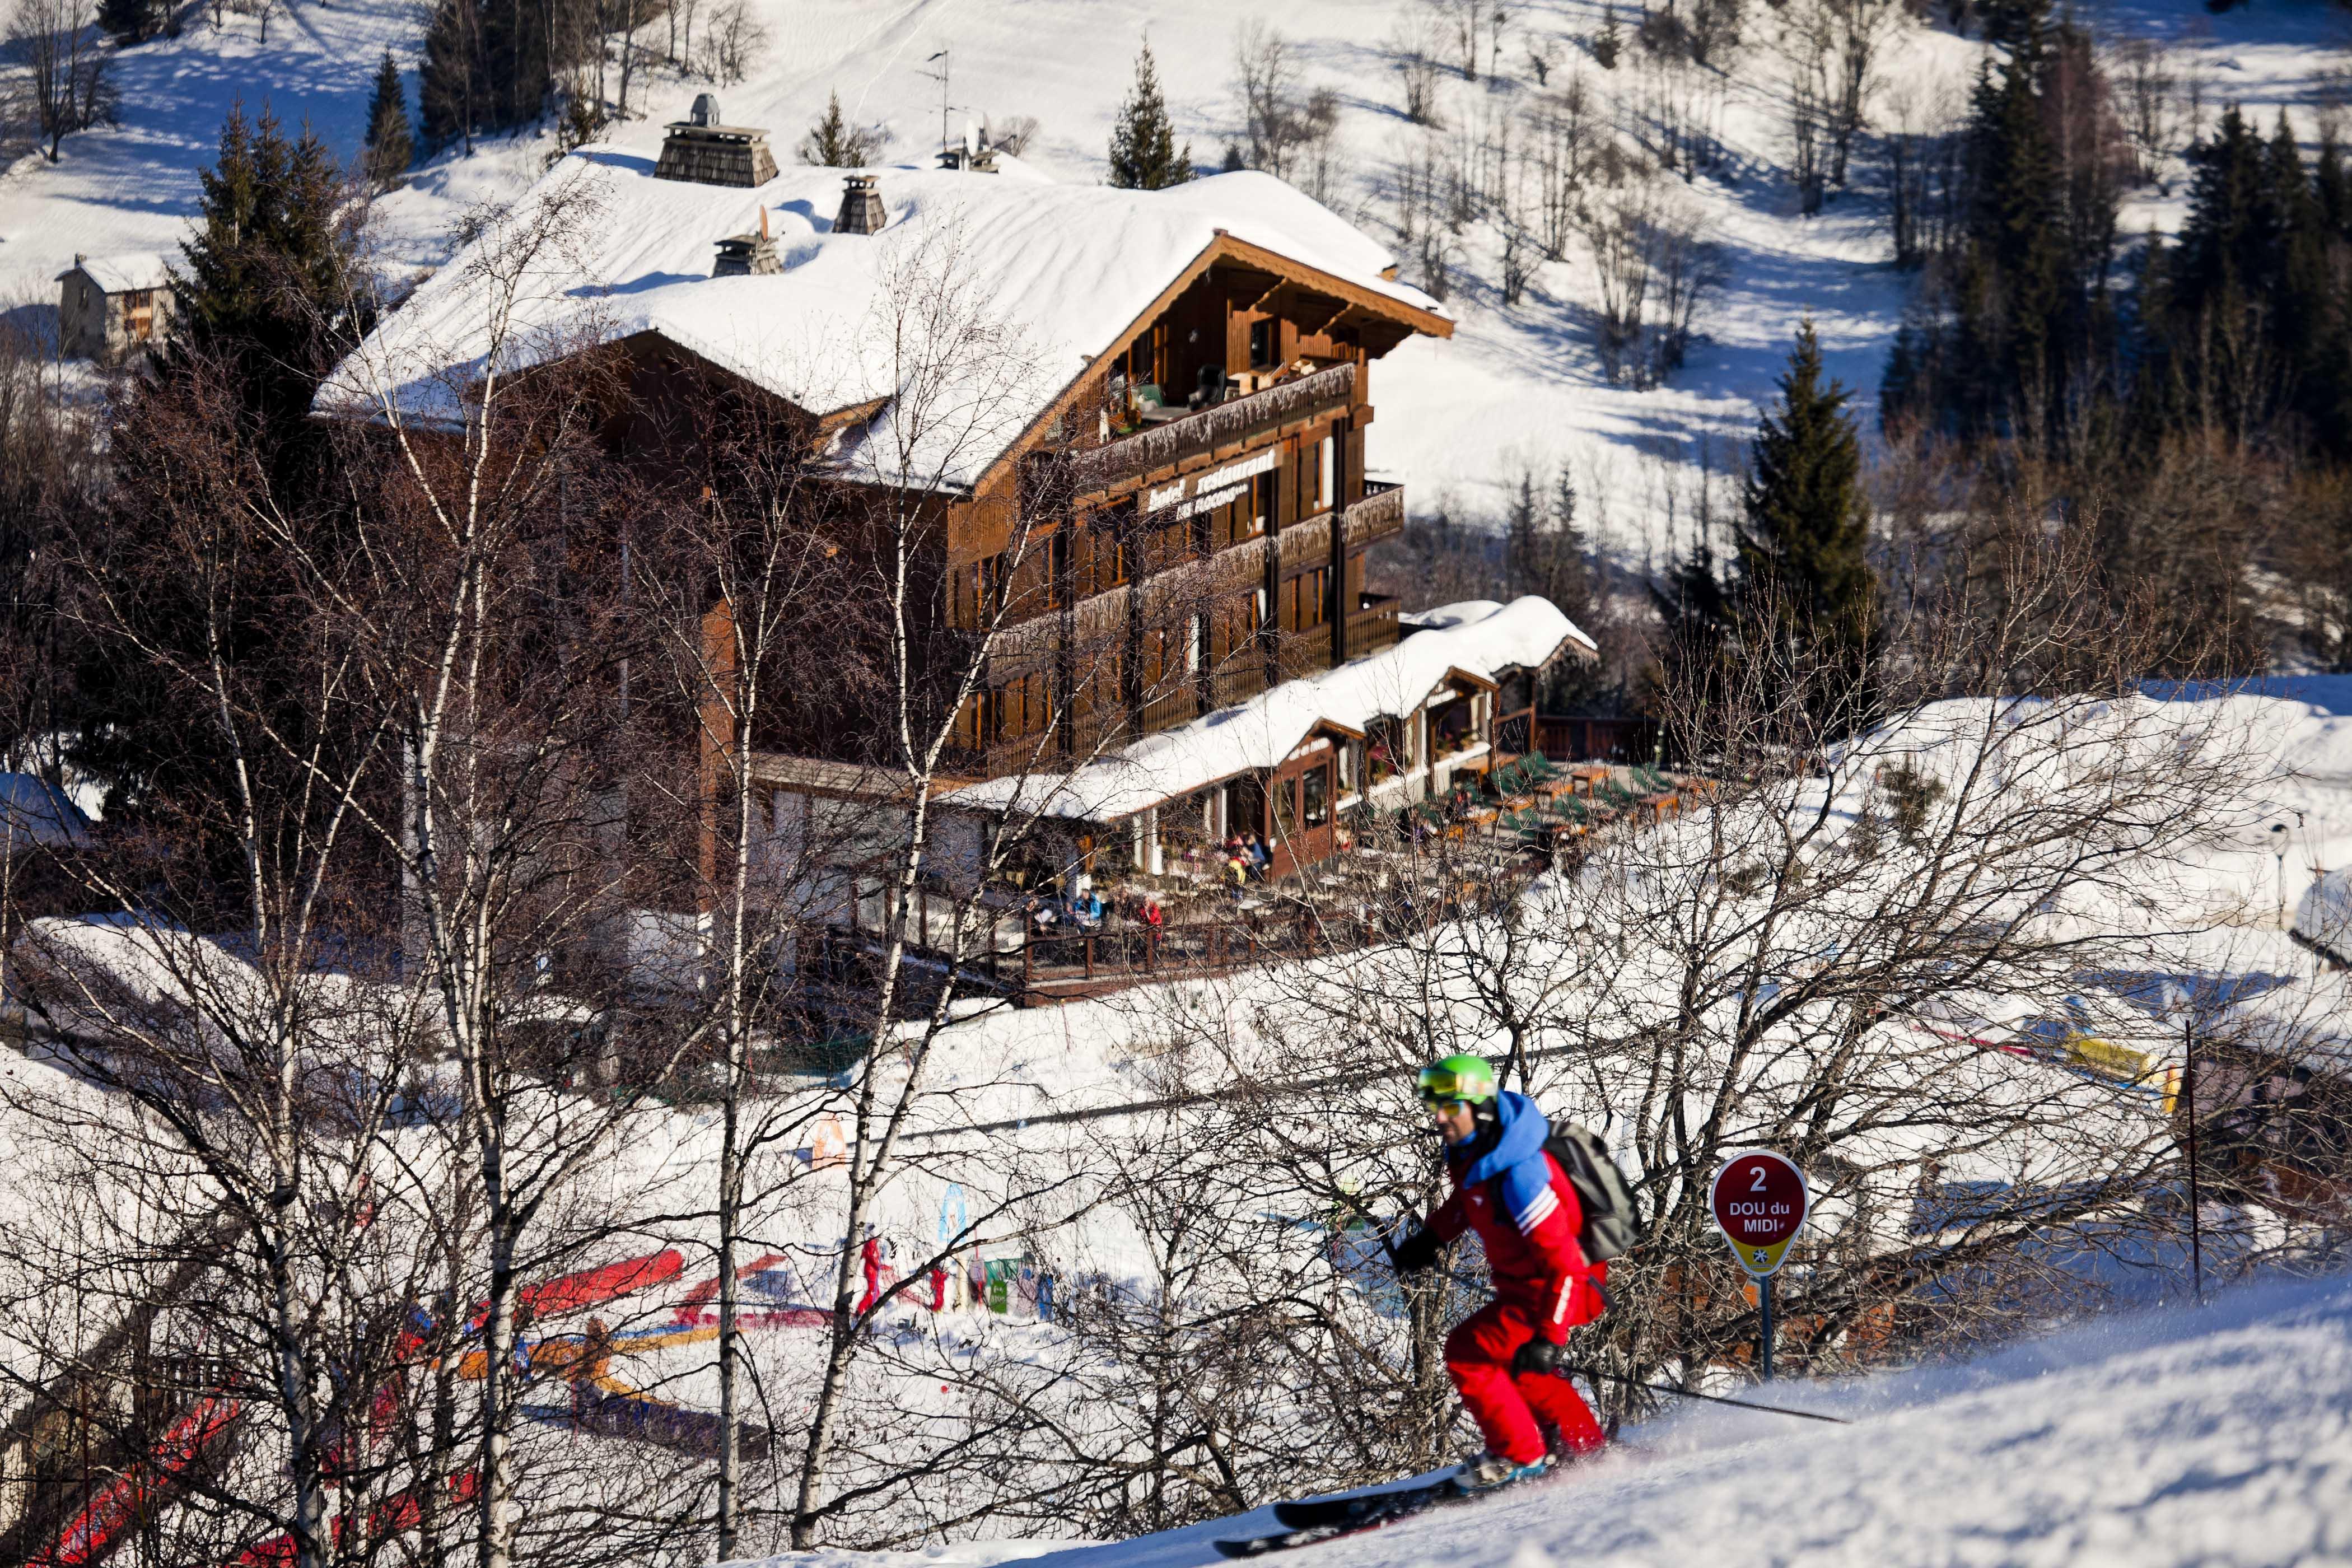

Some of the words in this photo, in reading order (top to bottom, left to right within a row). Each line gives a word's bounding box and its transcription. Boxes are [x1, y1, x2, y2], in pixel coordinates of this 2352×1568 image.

[1196, 448, 1276, 496] restaurant
[1749, 1166, 1767, 1192] 2
[1730, 1202, 1765, 1216] DOU
[1770, 1202, 1790, 1215] du
[1744, 1219, 1777, 1232] MIDI
